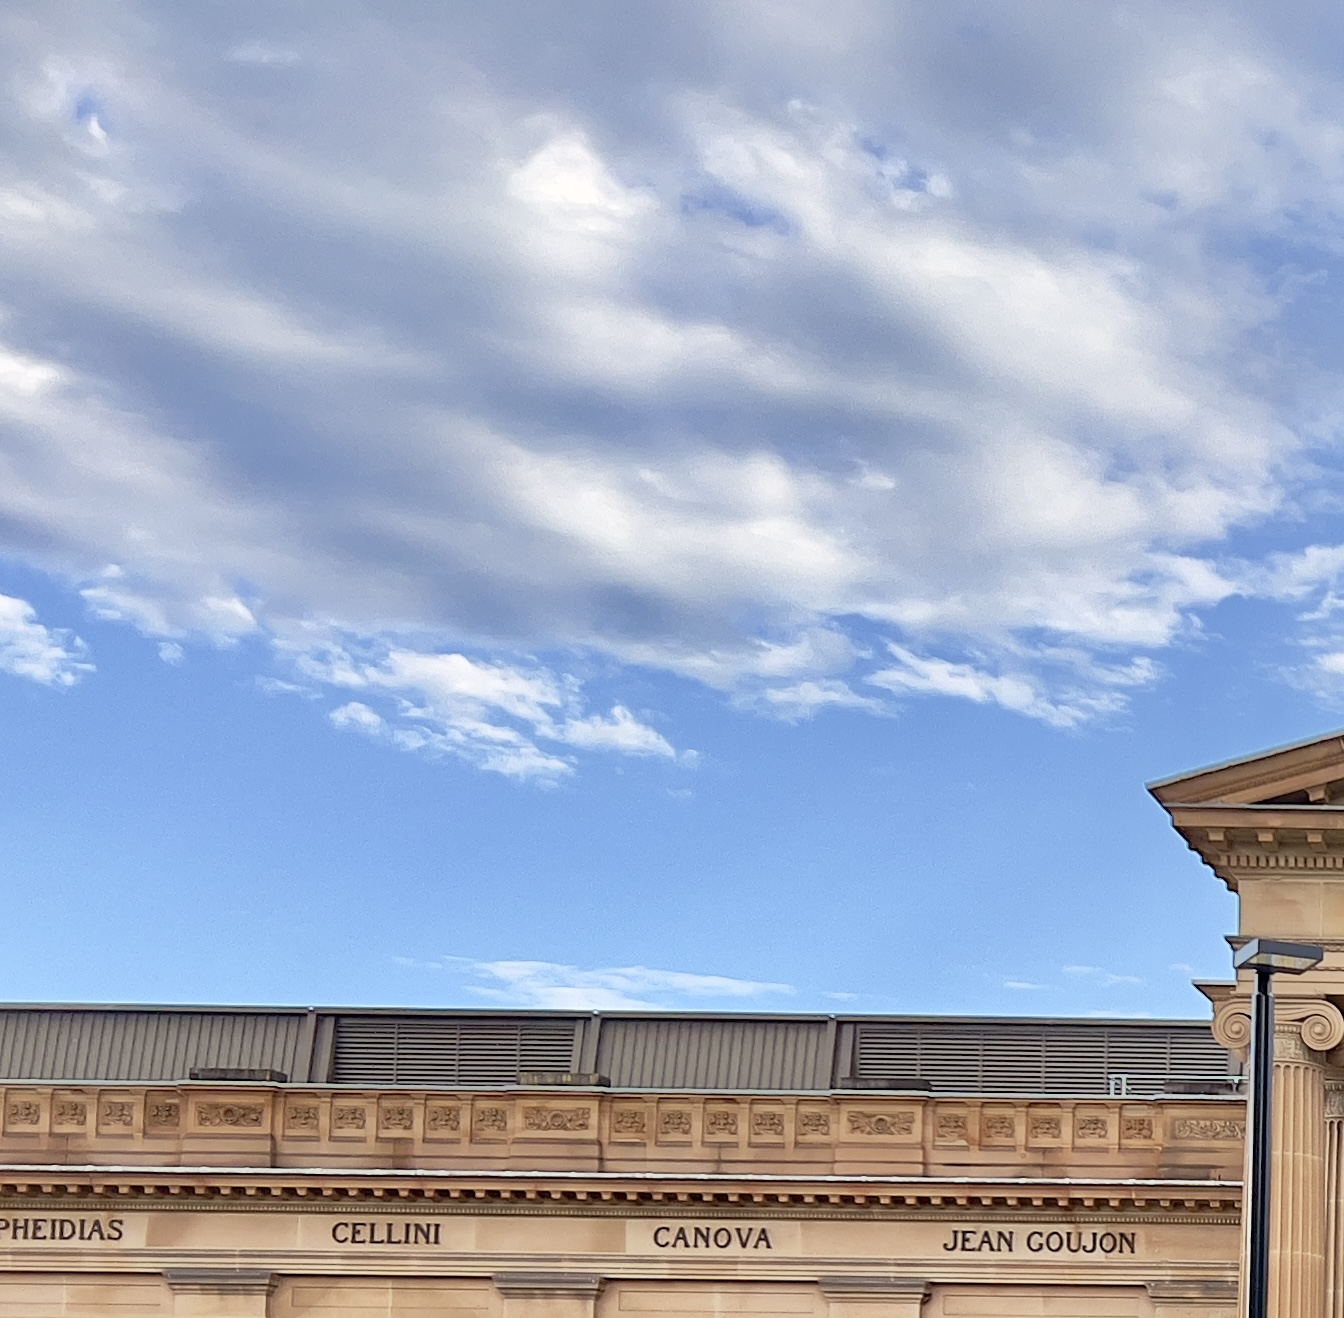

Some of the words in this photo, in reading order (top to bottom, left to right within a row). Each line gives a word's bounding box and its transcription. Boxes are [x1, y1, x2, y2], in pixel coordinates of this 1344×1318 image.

[0, 1218, 124, 1241] PHEIDIAS
[331, 1221, 441, 1245] CELLINI
[653, 1226, 772, 1249] CANOVA
[943, 1230, 1014, 1252] JEAN
[1026, 1231, 1136, 1254] GOUJON
